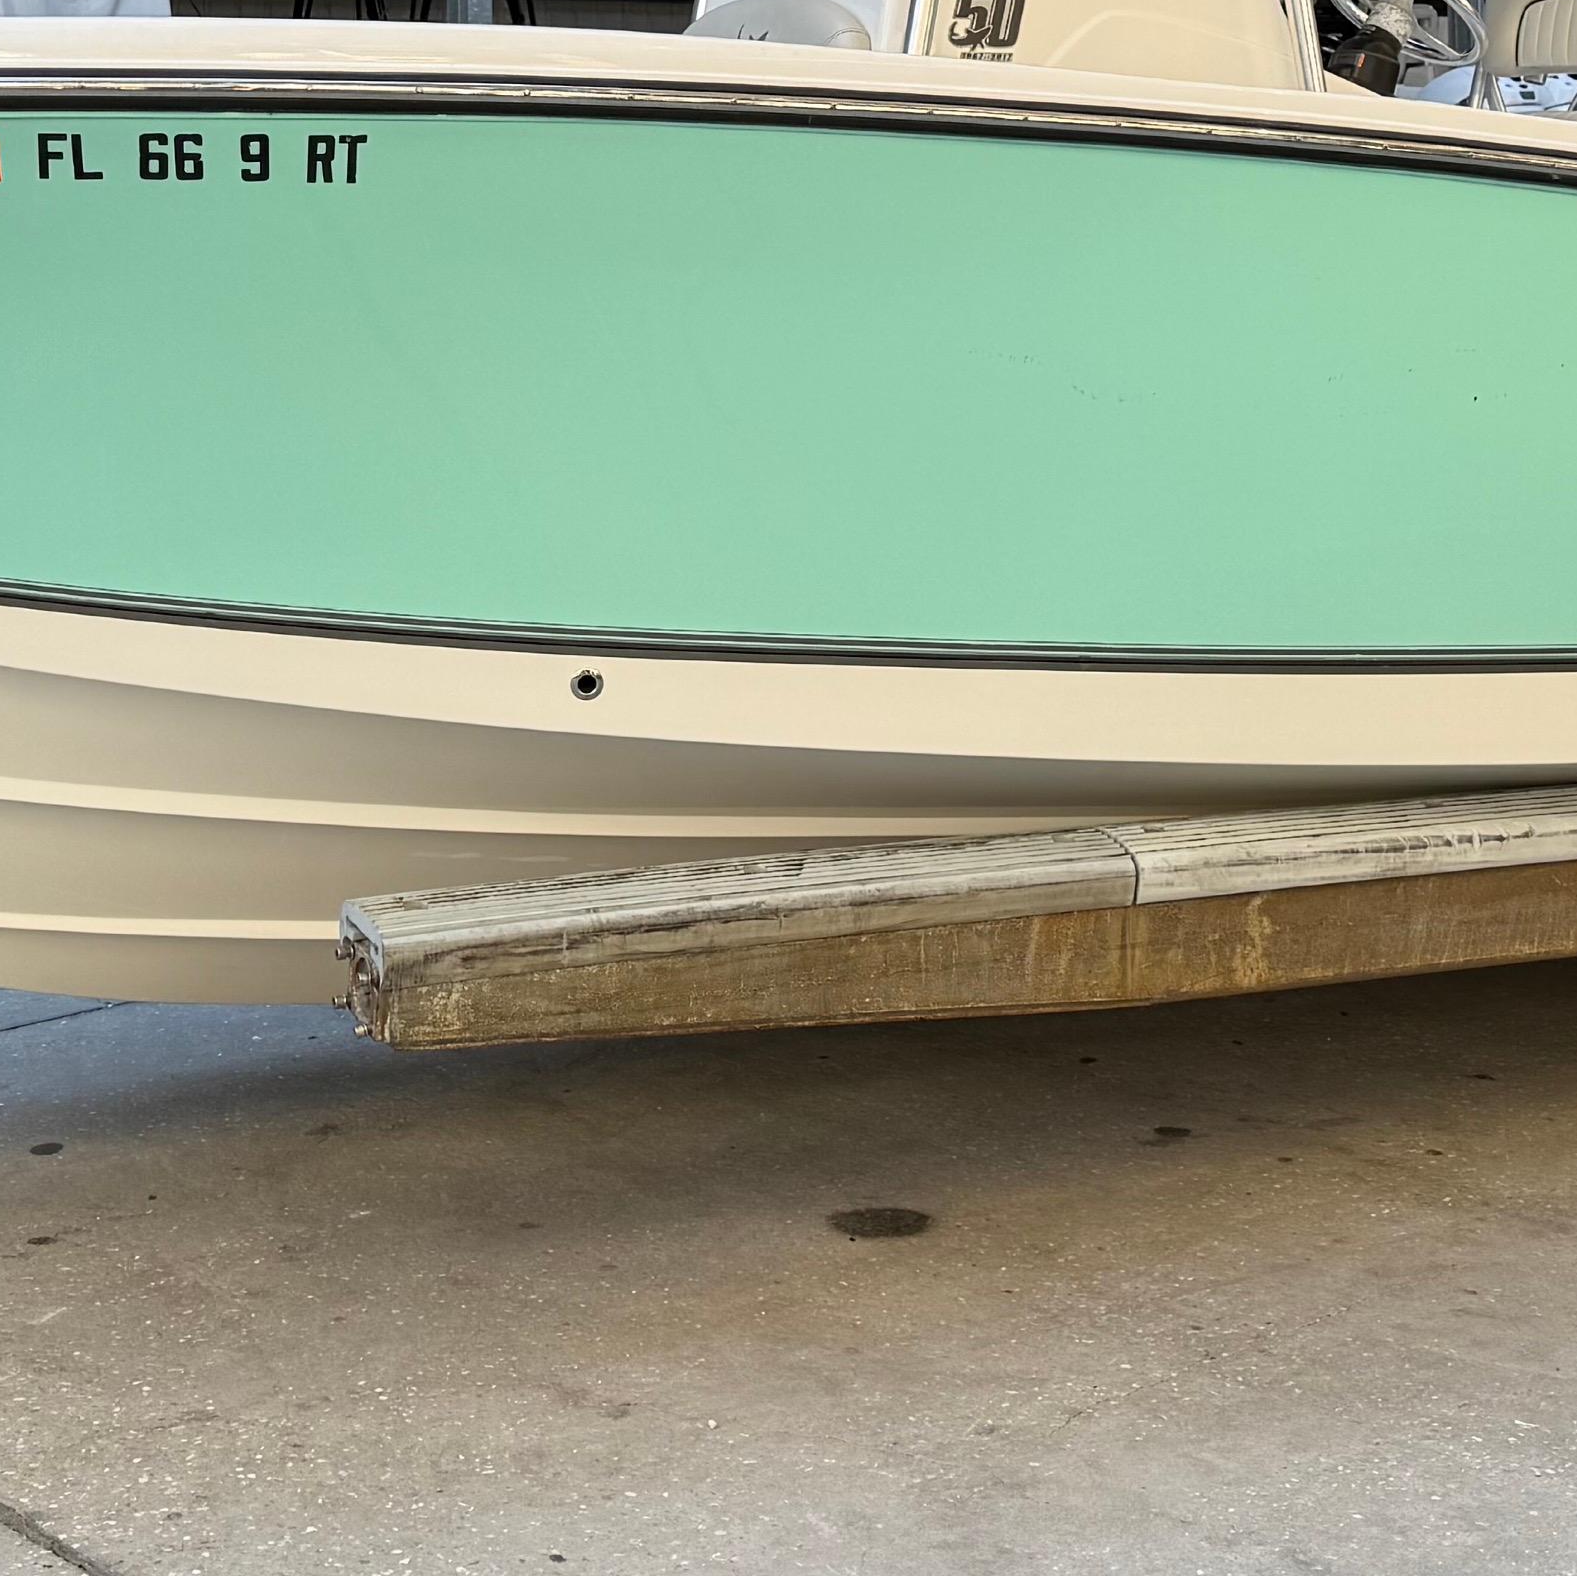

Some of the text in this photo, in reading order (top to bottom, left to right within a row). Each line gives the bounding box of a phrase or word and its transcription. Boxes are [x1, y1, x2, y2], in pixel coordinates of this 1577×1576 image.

[37, 132, 368, 183] FL 66 9 RT
